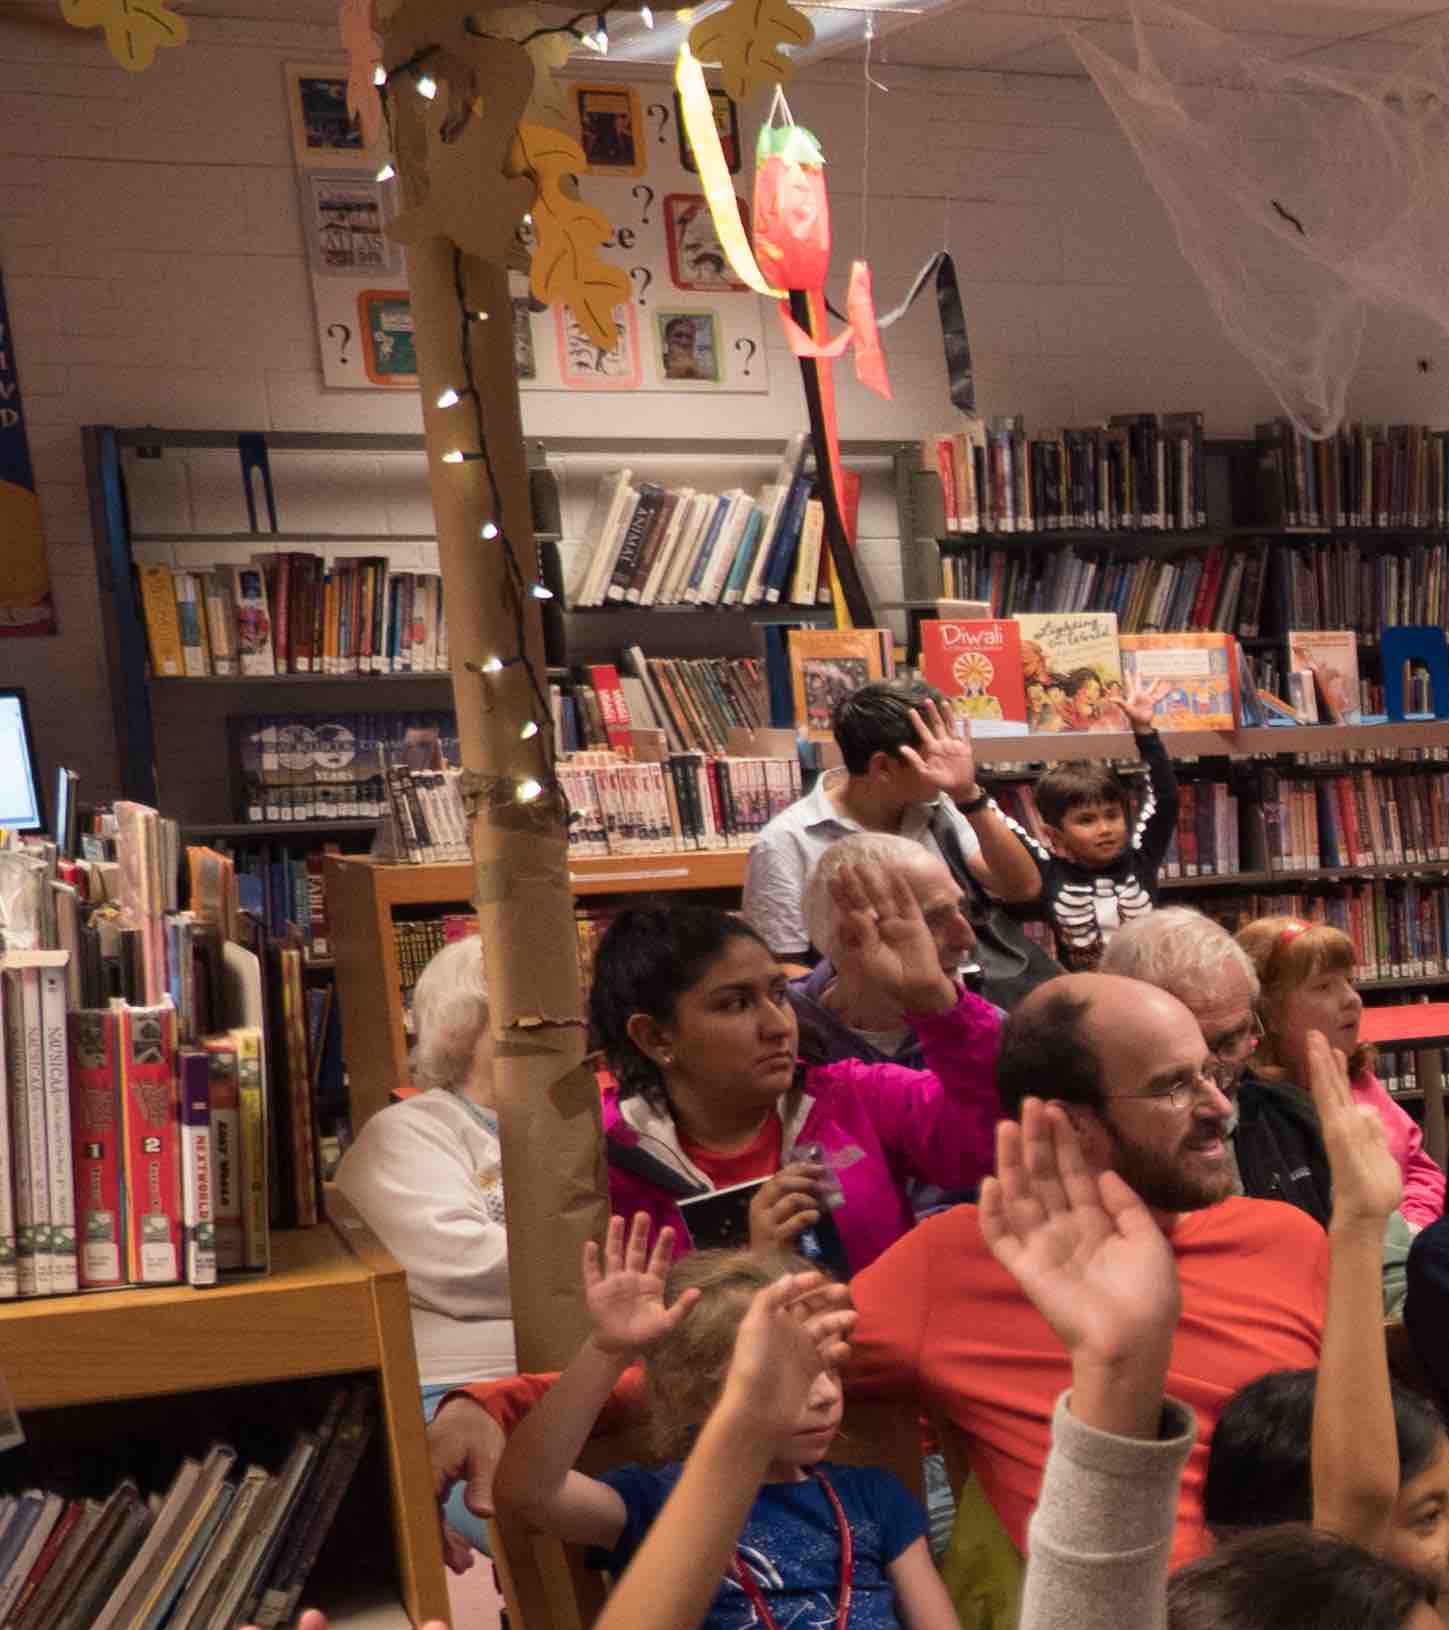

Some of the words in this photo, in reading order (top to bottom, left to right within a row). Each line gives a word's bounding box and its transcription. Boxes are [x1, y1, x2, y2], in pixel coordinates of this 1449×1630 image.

[620, 507, 648, 562] ANIMAL
[940, 623, 1004, 646] Diwali
[143, 1137, 161, 1153] 2
[195, 1135, 210, 1219] NEXTWORLD
